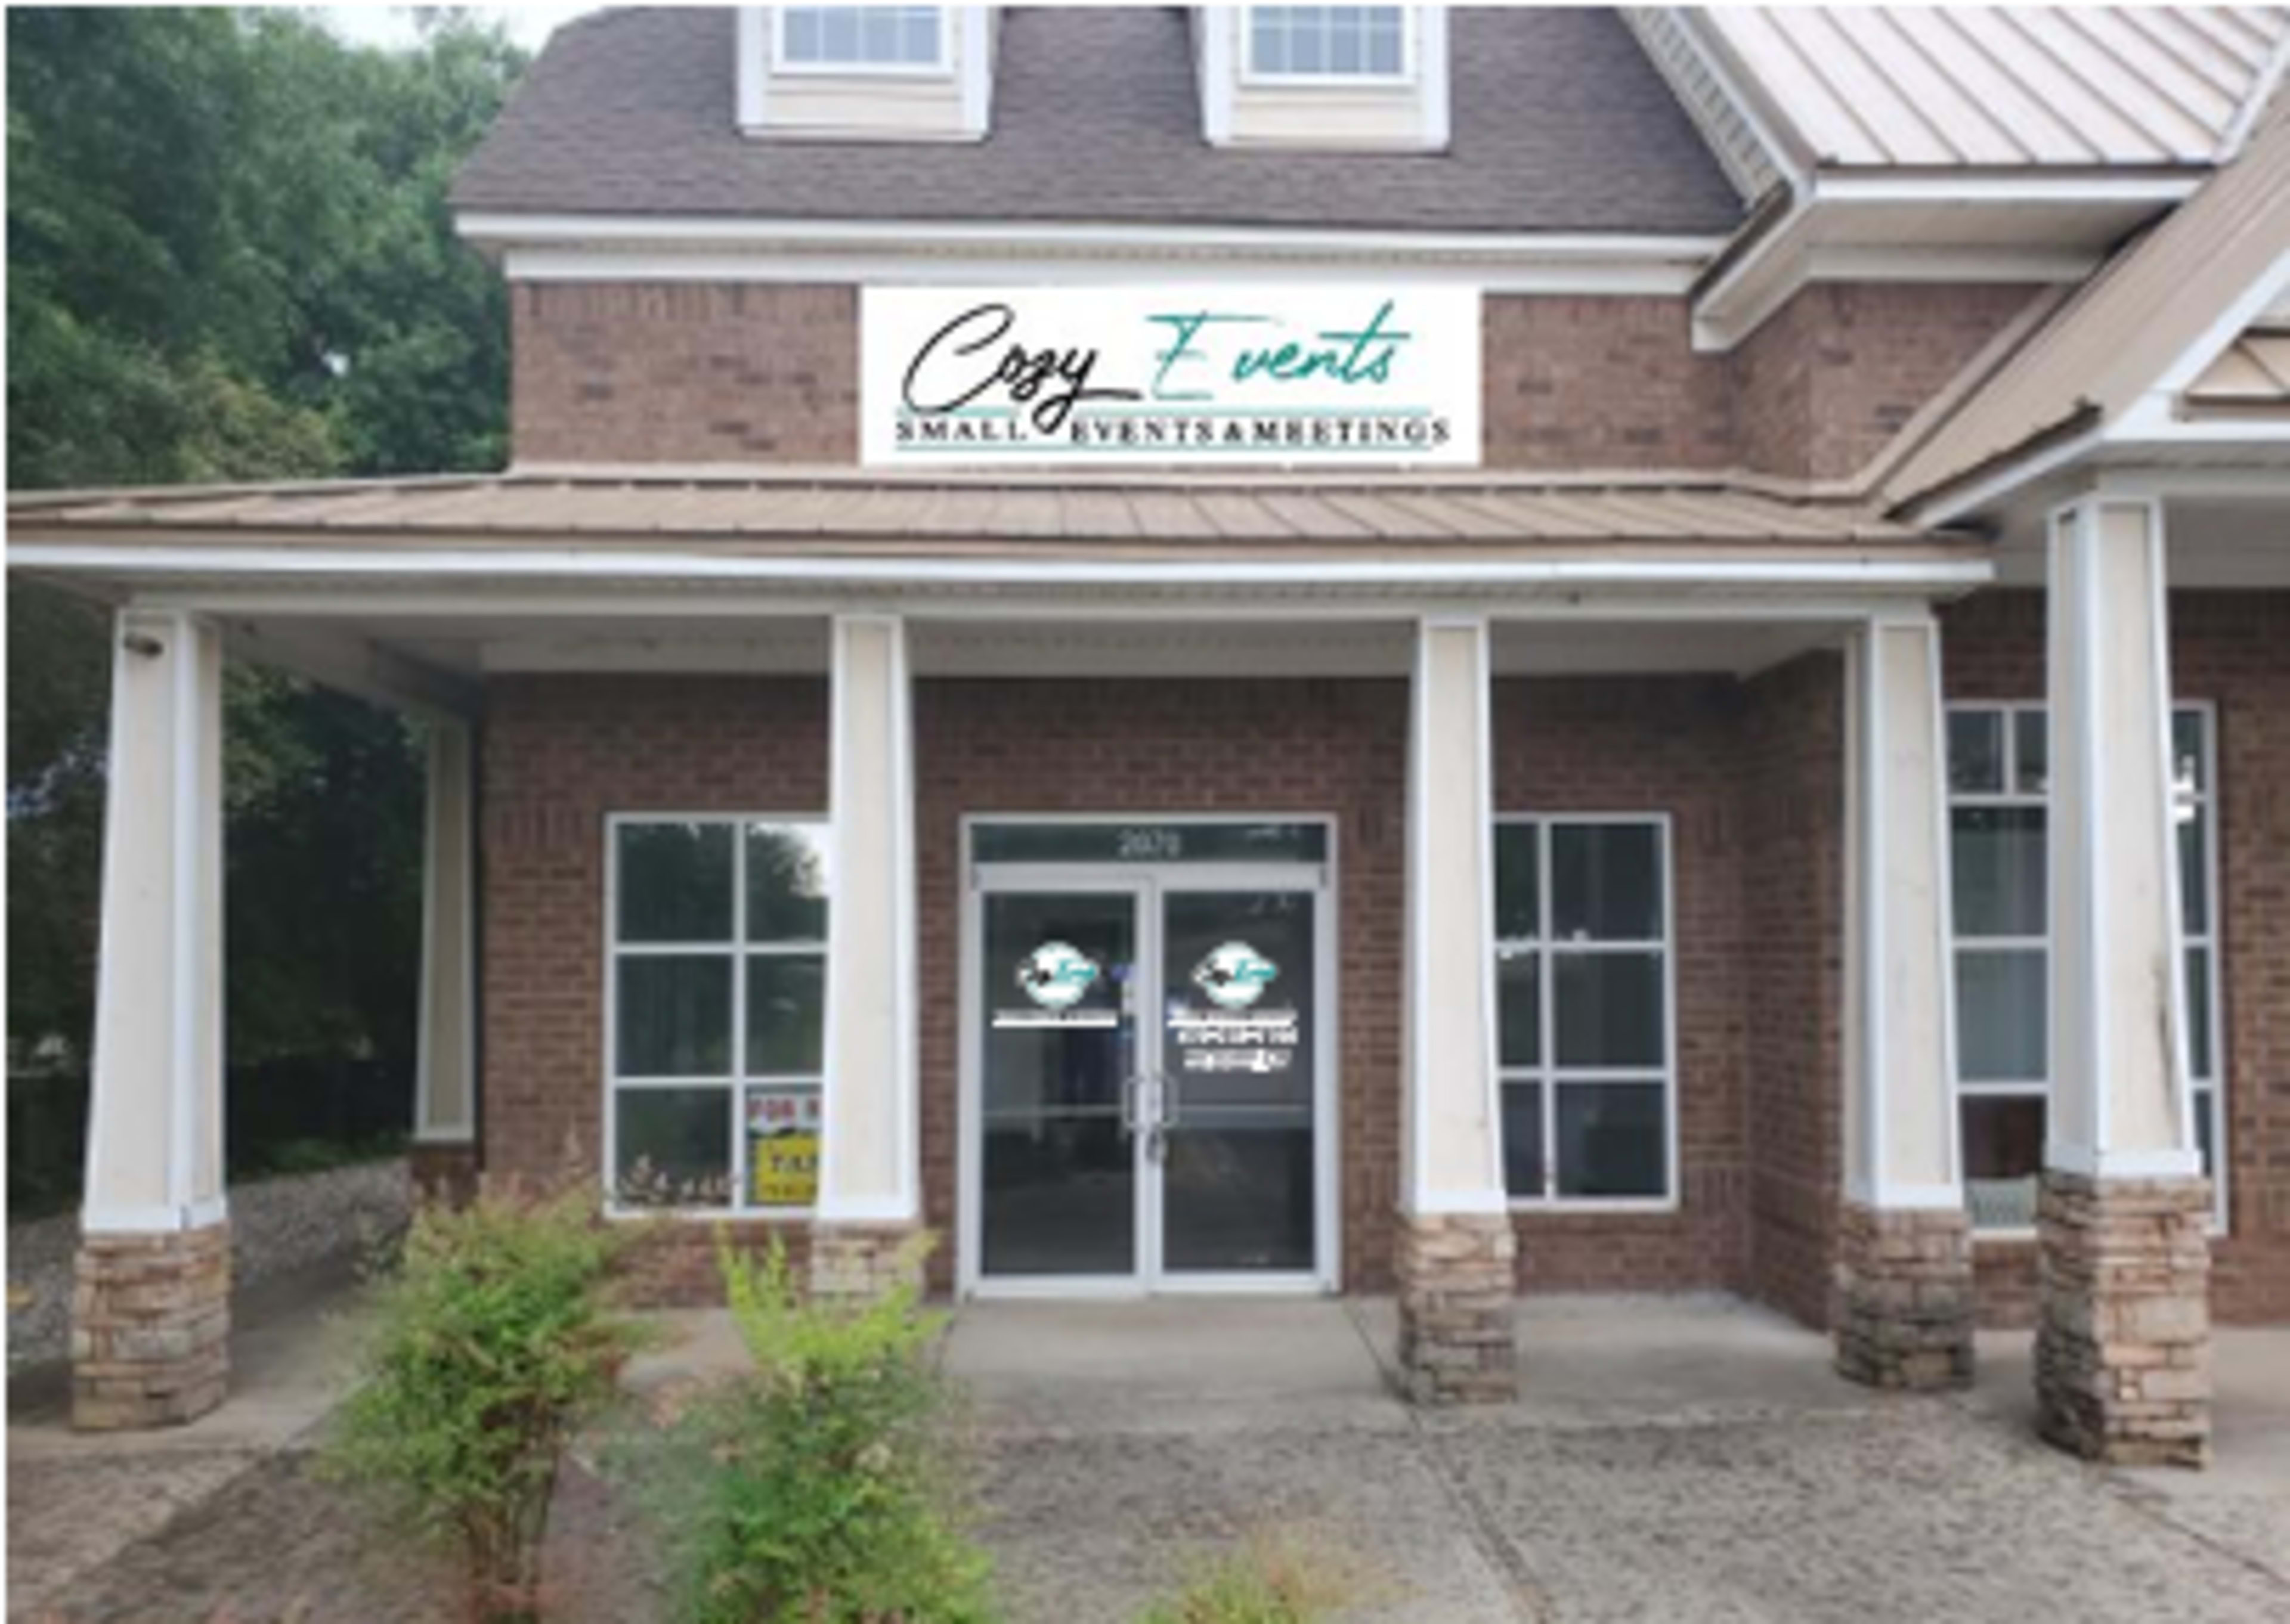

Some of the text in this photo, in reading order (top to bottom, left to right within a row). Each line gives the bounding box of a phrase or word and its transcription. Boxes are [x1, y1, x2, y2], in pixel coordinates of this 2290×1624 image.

[902, 299, 1411, 434] Cozy Events
[896, 420, 1028, 442] SMALL
